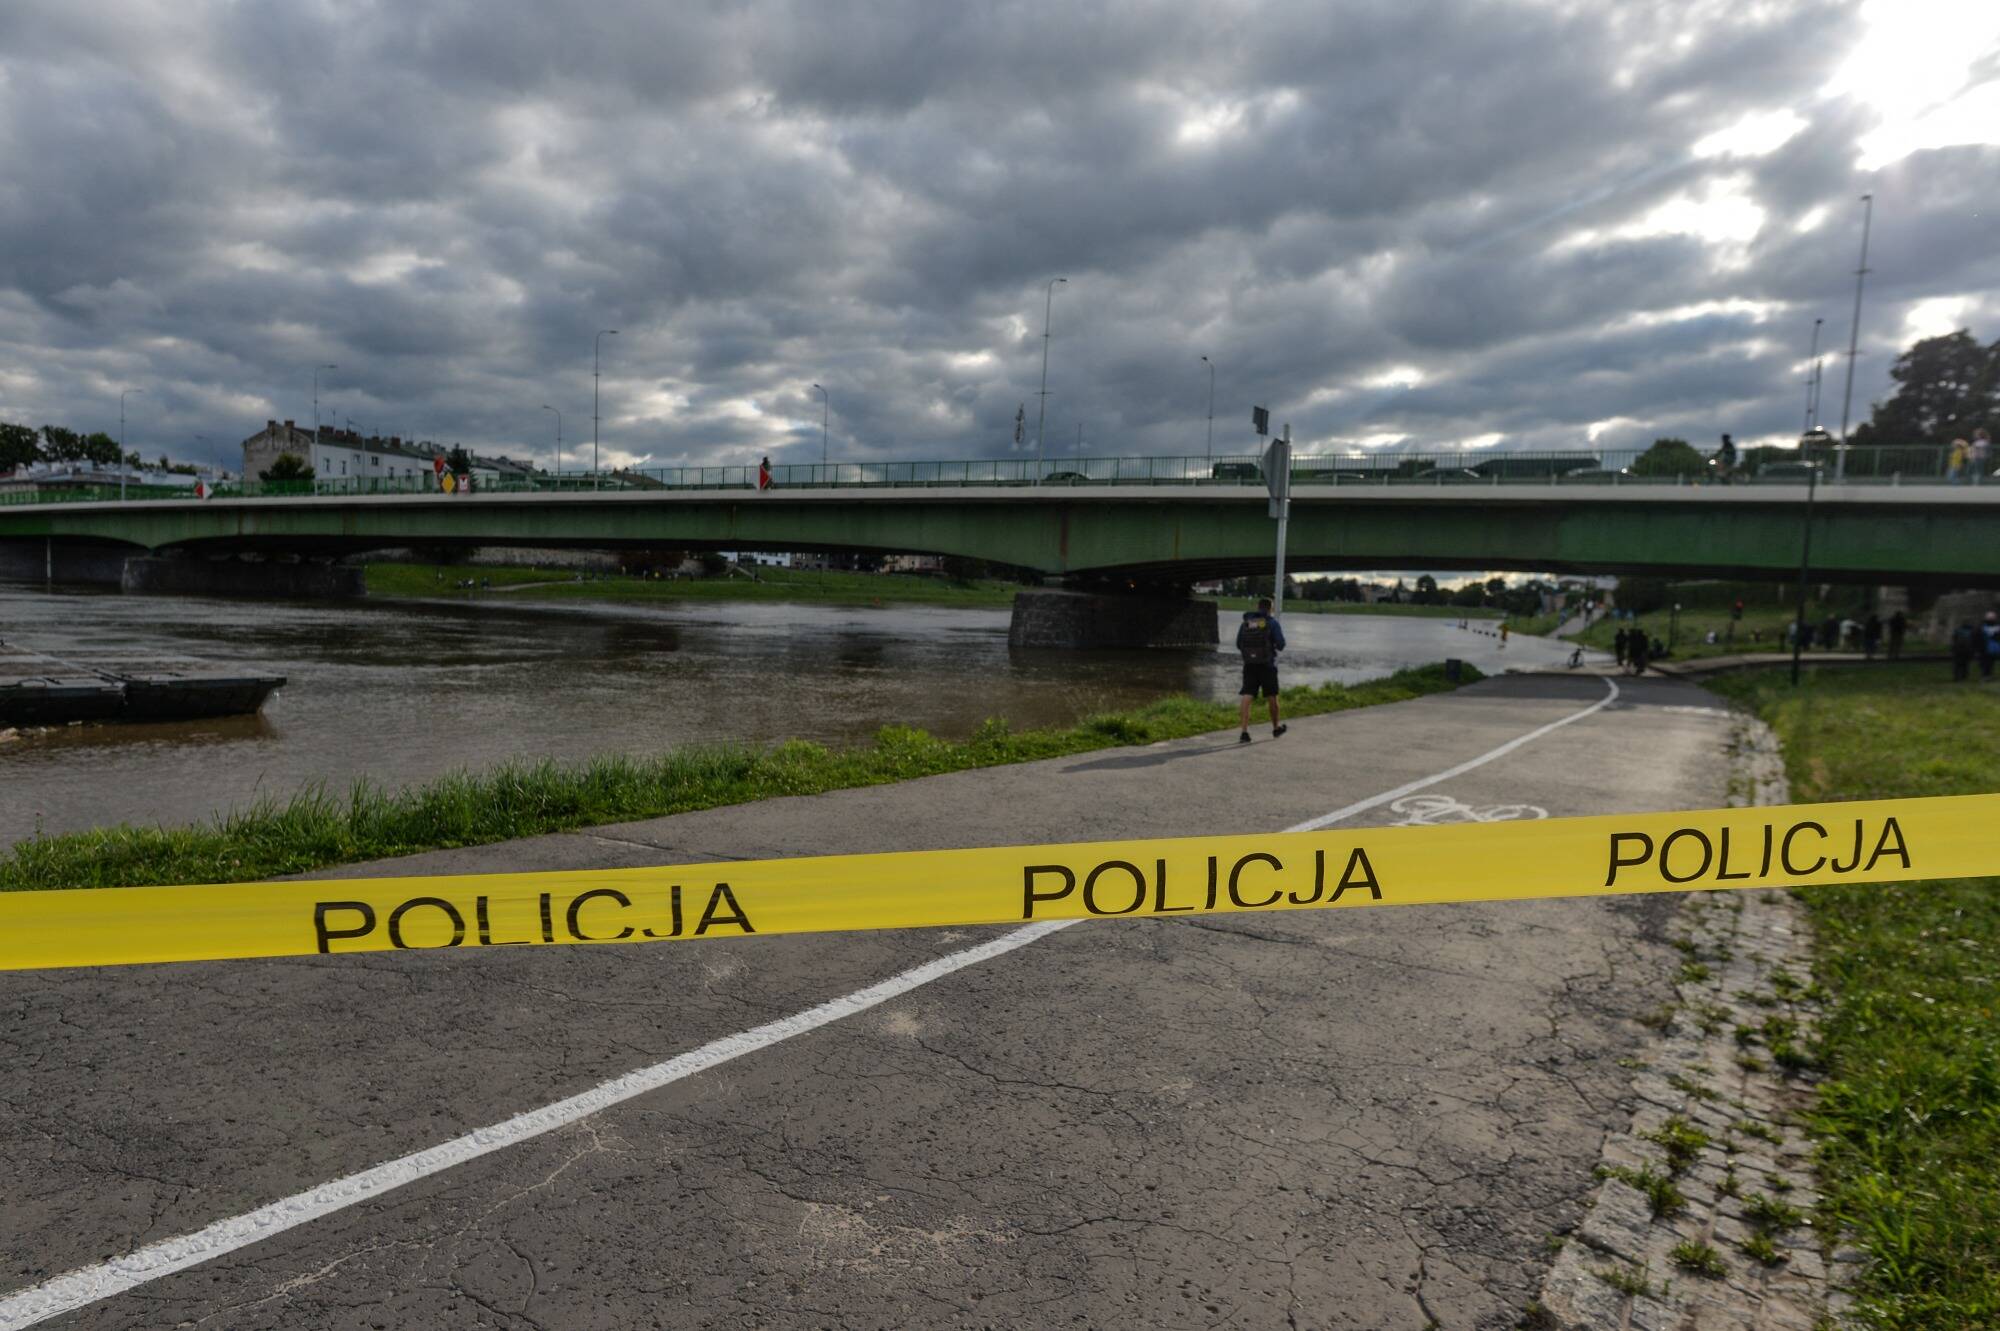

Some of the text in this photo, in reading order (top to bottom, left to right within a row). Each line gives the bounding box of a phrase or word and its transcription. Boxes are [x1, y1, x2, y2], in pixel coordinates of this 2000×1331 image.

[314, 817, 1911, 953] POLICJA POLICJA POLICJA
